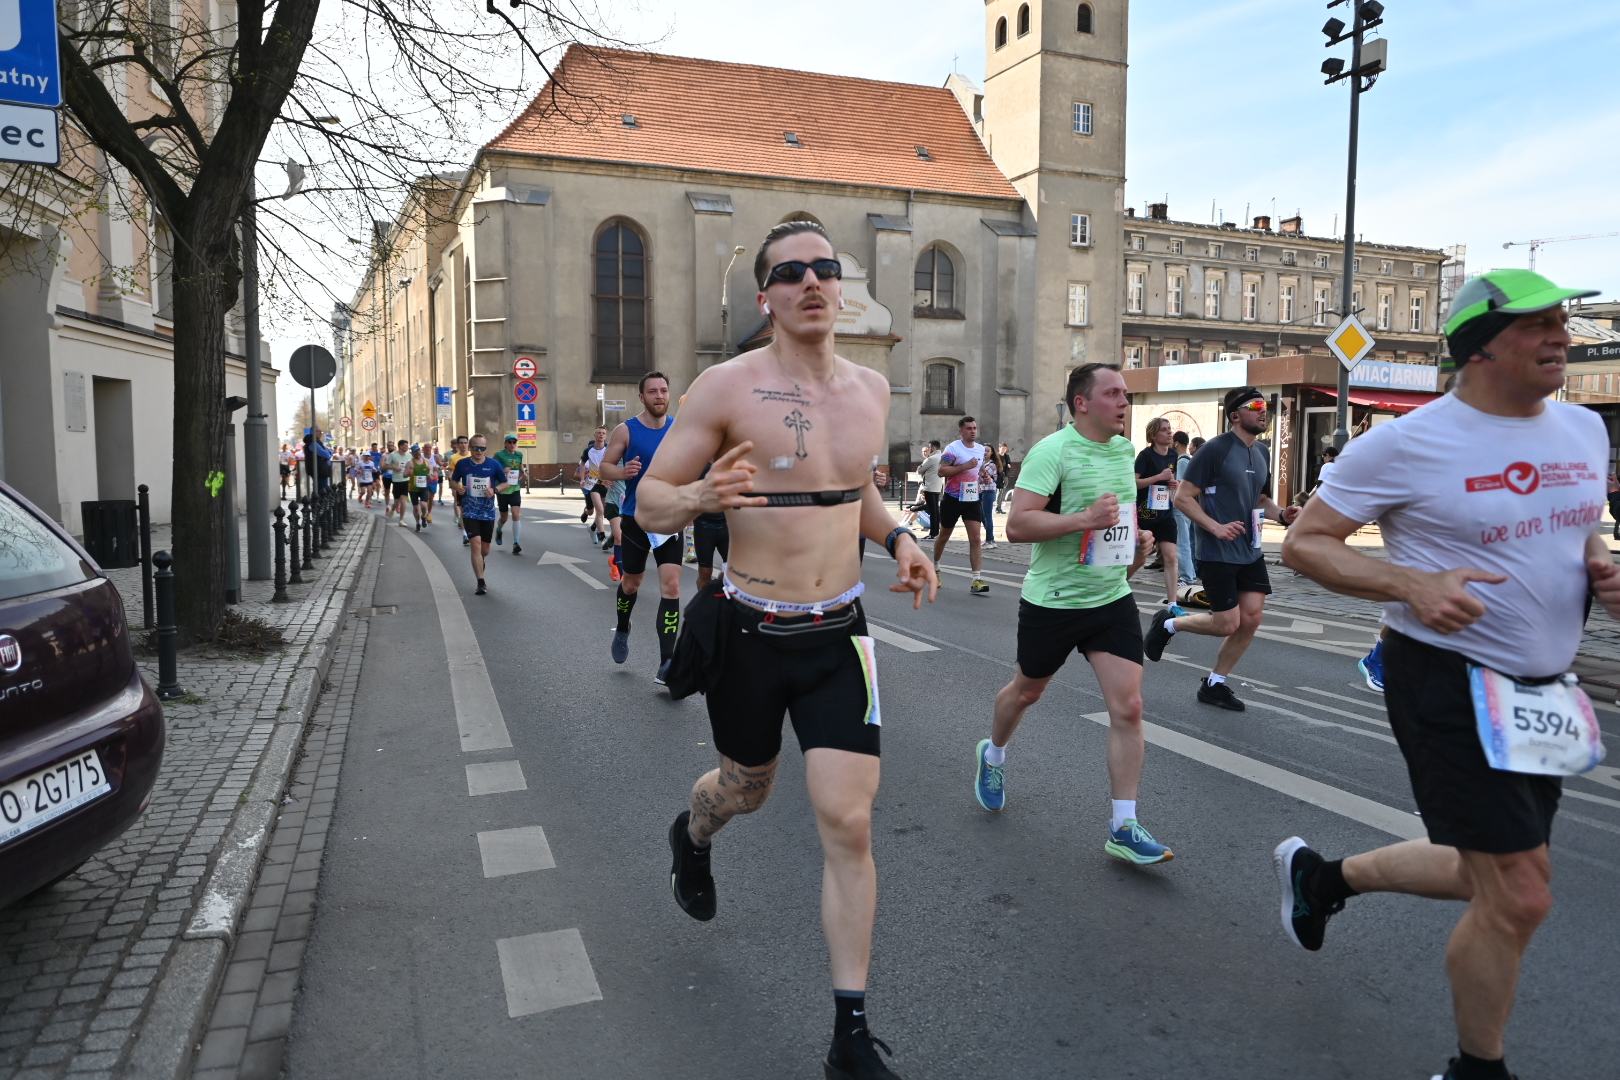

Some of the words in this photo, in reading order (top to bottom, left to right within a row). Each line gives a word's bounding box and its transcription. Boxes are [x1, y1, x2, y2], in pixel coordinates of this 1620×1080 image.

[1587, 347, 1599, 356] Pl.
[363, 420, 374, 428] 30
[1541, 462, 1589, 473] CHALLENGE
[1103, 526, 1129, 542] 6177
[1481, 525, 1509, 545] we
[1515, 516, 1544, 539] are
[0, 644, 17, 664] FIAT
[1513, 706, 1580, 741] 5394
[26, 753, 100, 814] 2G775
